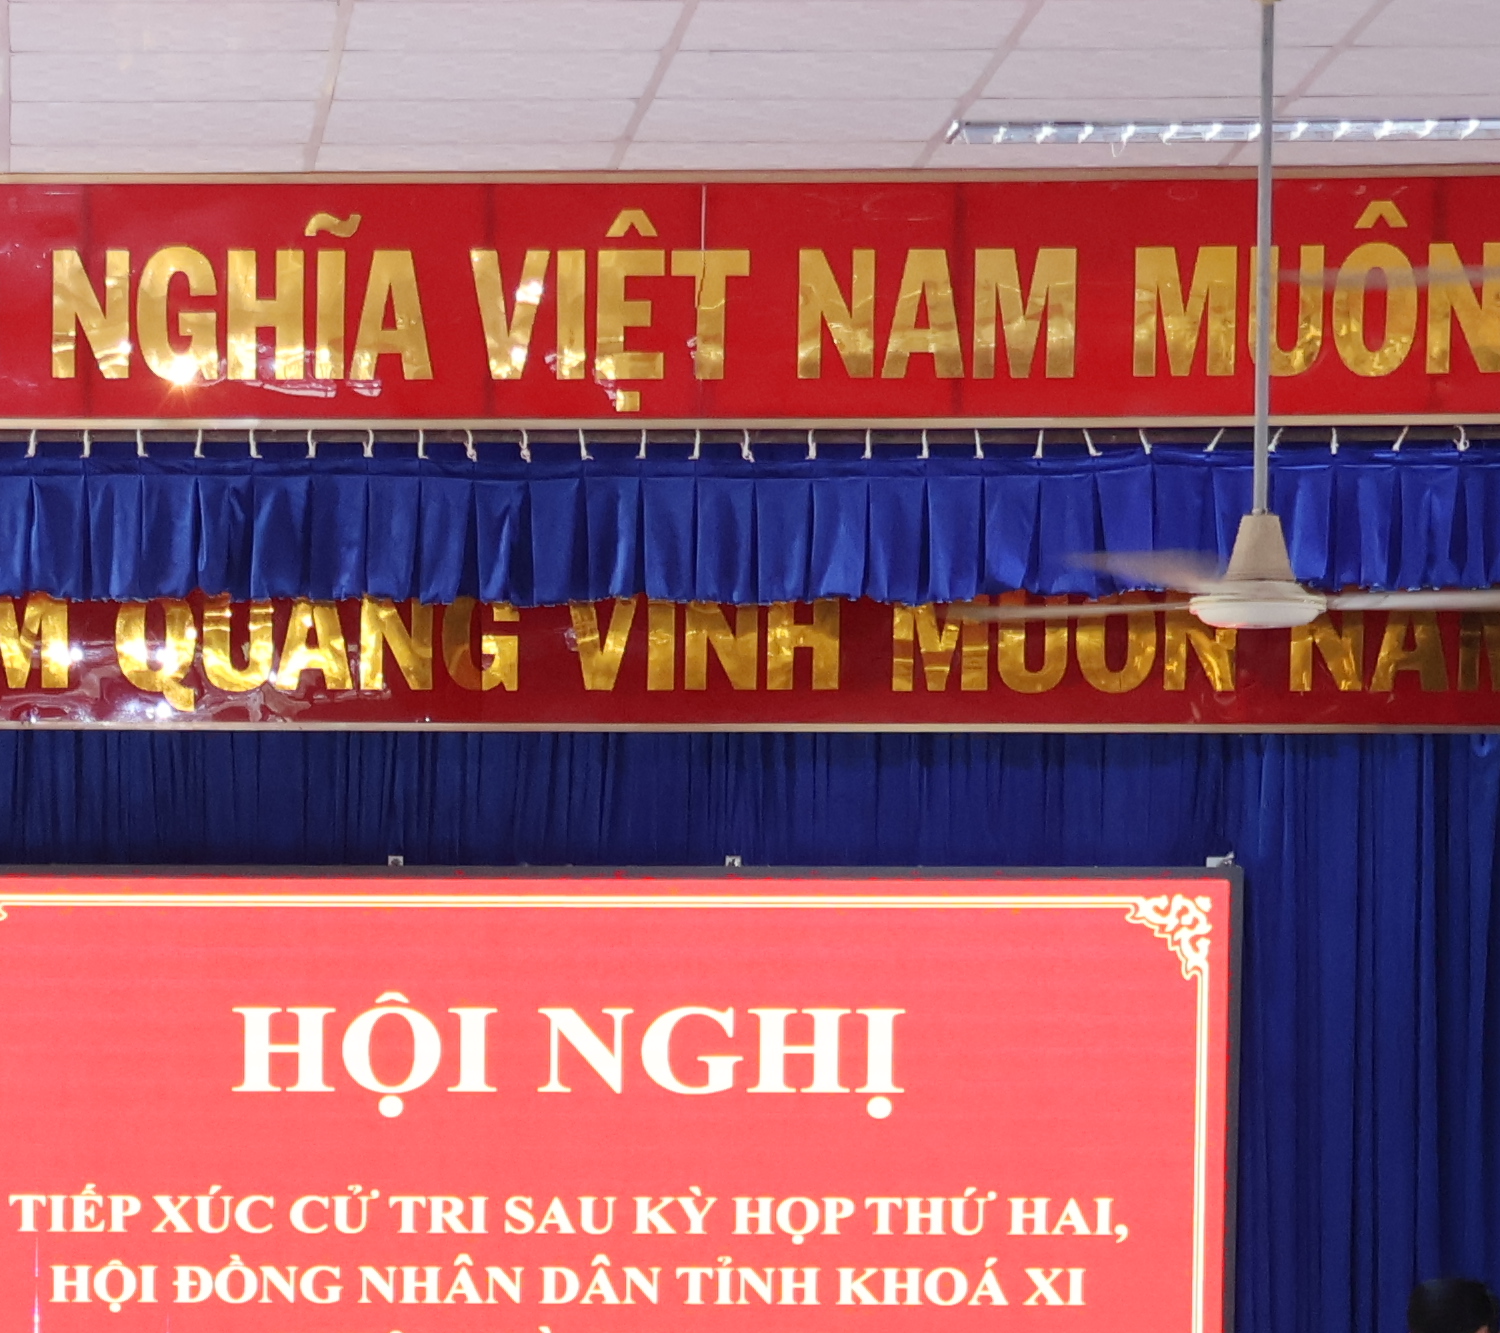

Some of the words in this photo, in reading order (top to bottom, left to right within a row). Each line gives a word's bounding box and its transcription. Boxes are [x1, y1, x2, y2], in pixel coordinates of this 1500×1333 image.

[51, 213, 433, 381] NGHĨA
[470, 209, 750, 412] VIỆT
[797, 247, 1077, 379] NAM
[115, 597, 520, 711] QUANG
[567, 598, 842, 692] VINH
[232, 991, 498, 1118] HỘI
[537, 1006, 906, 1119] NGHỊ
[9, 1183, 141, 1232] TIẾP
[152, 1185, 274, 1233] XÚC
[290, 1184, 380, 1234] CỬ
[389, 1196, 488, 1233] TRI
[504, 1196, 617, 1234] SAU
[633, 1186, 717, 1234] KỲ
[732, 1197, 855, 1245] HỌP
[865, 1187, 997, 1235] THỨ
[1008, 1197, 1128, 1243] HAI,
[50, 1259, 158, 1312] HỘI
[172, 1254, 343, 1304] ĐỒNG
[358, 1253, 524, 1304] NHÂN
[539, 1254, 662, 1304] DÂN
[676, 1256, 820, 1305] TỈNH
[836, 1257, 1009, 1306] KHOÁ
[1023, 1268, 1086, 1305] XI
